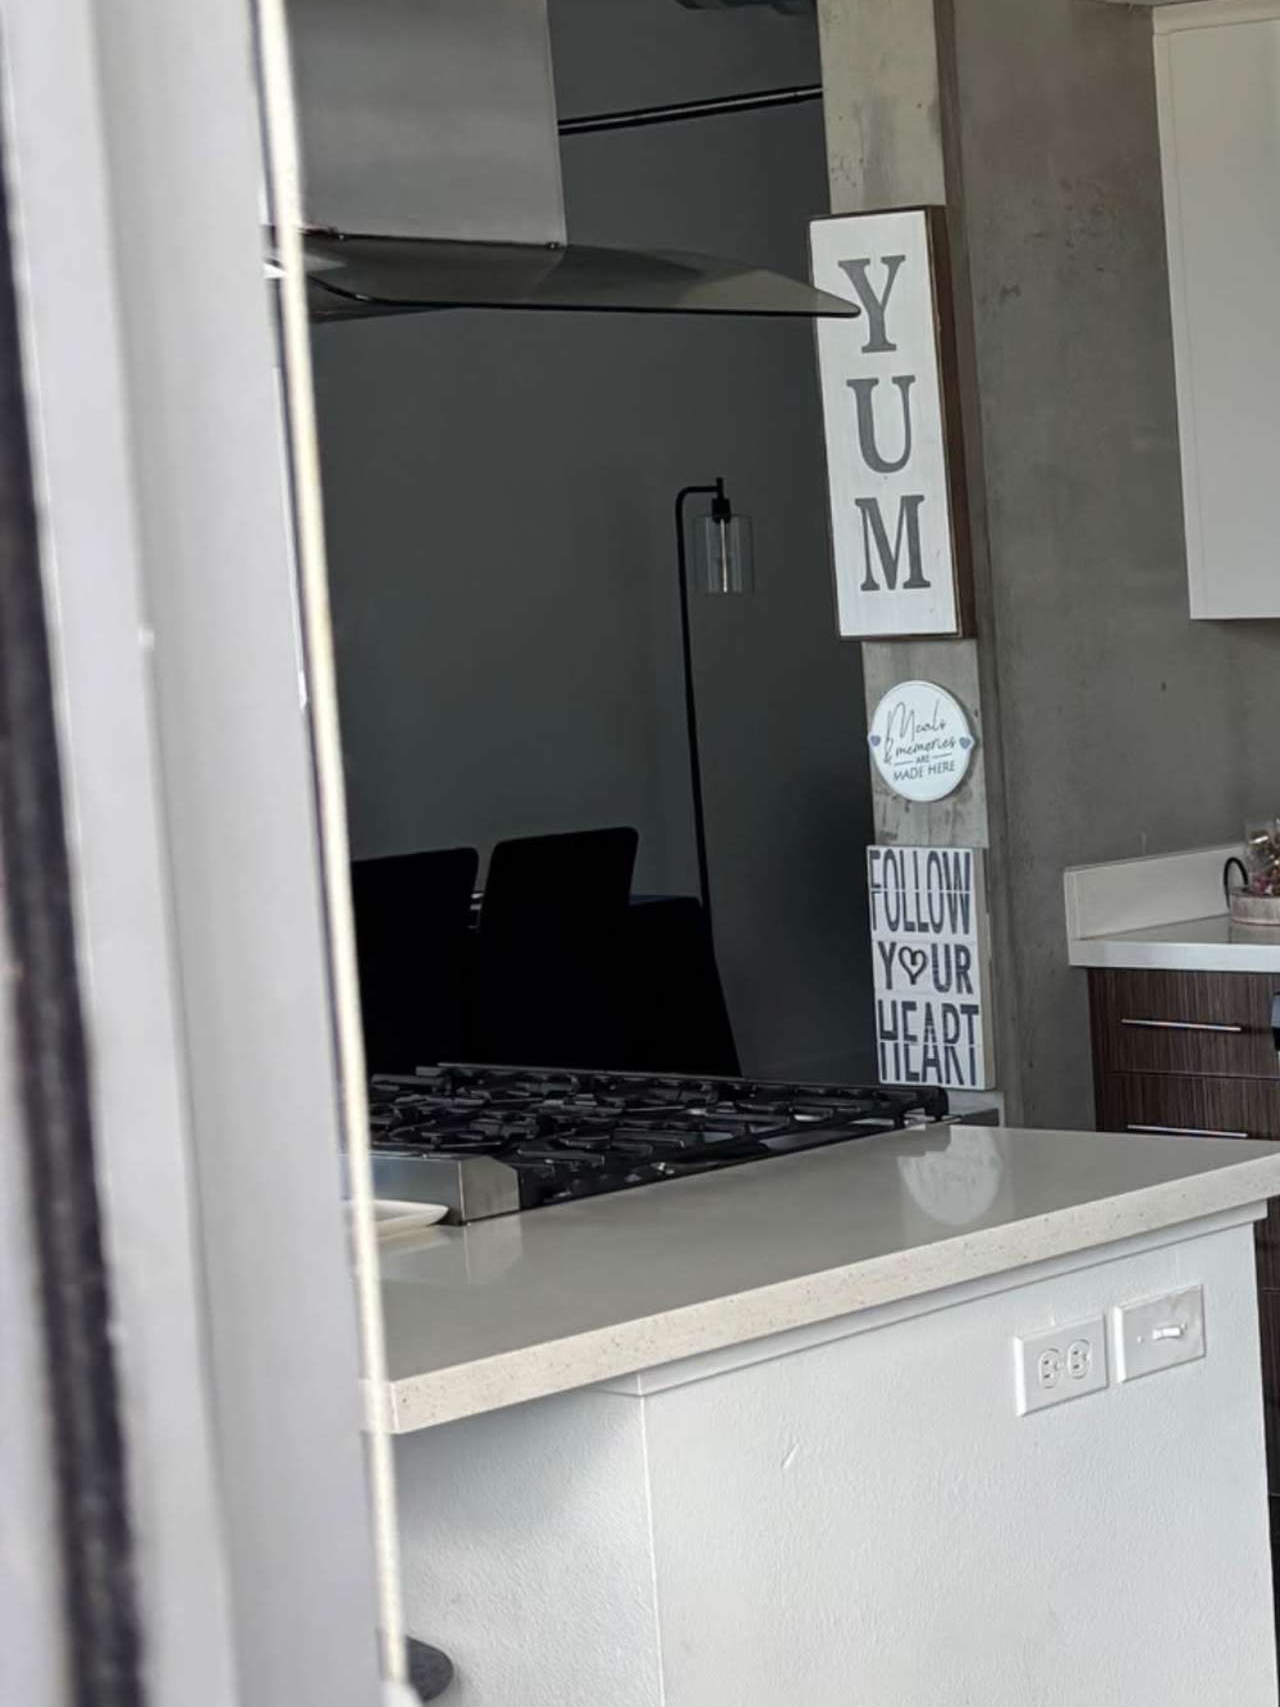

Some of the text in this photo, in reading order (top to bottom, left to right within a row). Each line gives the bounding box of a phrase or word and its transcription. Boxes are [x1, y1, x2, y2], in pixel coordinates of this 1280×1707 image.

[837, 254, 932, 592] YUM
[885, 698, 946, 743] Meals
[895, 735, 956, 757] memories
[915, 754, 930, 764] ARE
[893, 760, 955, 781] MADE HERE
[868, 848, 971, 935] FOLLOW
[877, 999, 979, 1086] HEART
